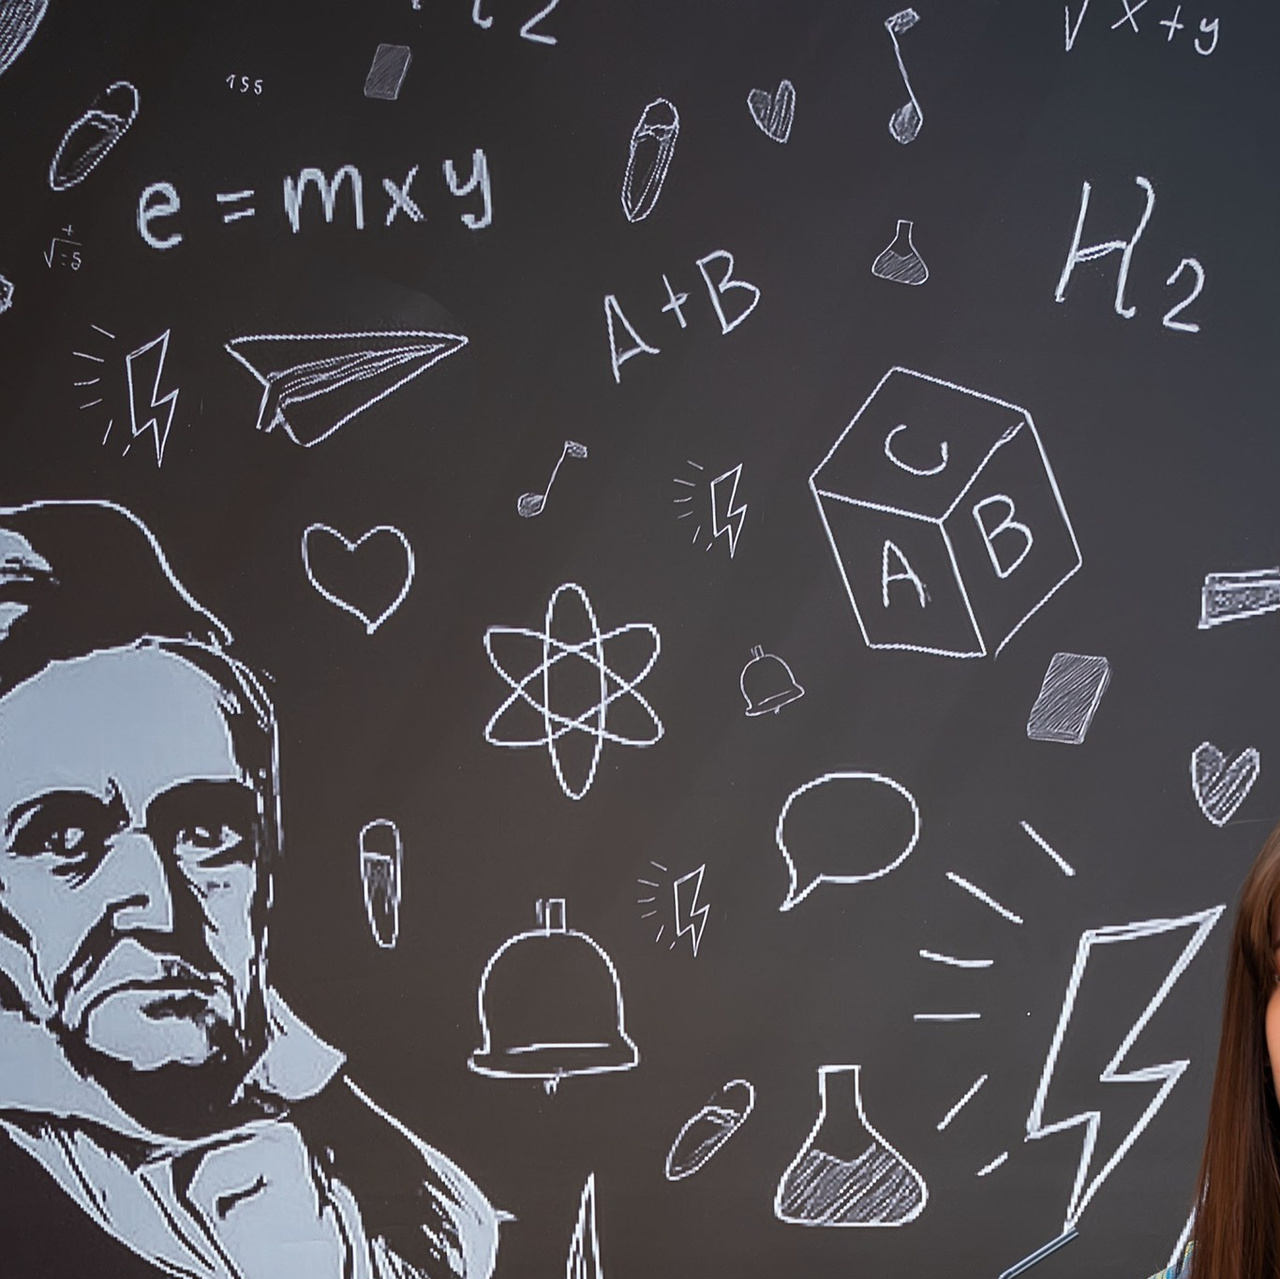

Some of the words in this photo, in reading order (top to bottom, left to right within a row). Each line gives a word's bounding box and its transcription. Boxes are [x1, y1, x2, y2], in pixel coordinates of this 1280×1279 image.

[884, 424, 949, 476] C
[972, 494, 1034, 579] B
[881, 539, 932, 608] A
